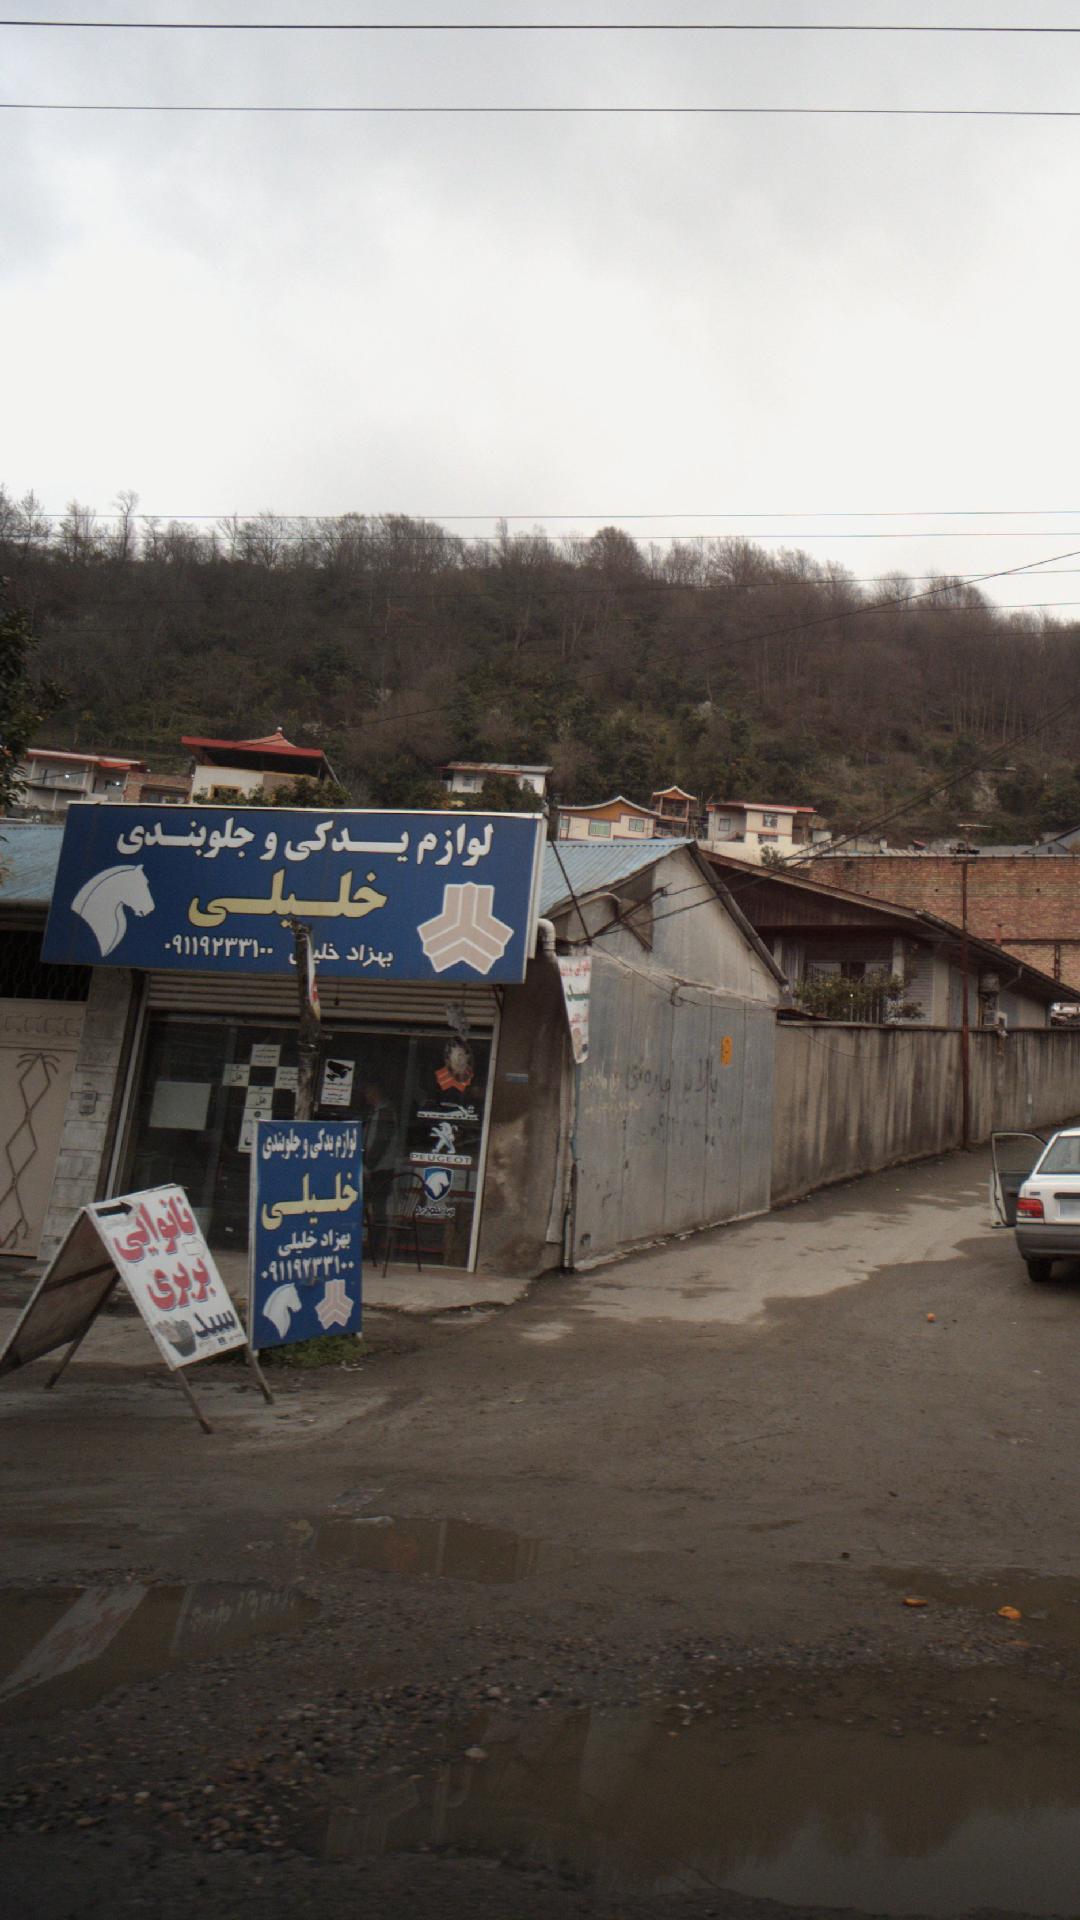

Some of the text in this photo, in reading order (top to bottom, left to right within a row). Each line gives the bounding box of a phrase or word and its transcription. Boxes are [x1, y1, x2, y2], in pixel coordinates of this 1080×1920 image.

[116, 816, 494, 867] لوازم یدکی و جلوبندی
[188, 868, 388, 928] خلیلی
[164, 933, 274, 959] ۰۹۱۱۹۲۳۳۱۰۰
[262, 1127, 358, 1160] لوازم یدکی و جلوبندی
[411, 1153, 471, 1164] PEUGEOT
[261, 1171, 359, 1230] خلیلی
[277, 1228, 352, 1257] بهزاد خلیلی
[144, 1257, 217, 1312] بربری
[261, 1255, 355, 1282] ۰۹۱۱۹۲۳۳۱۰۰
